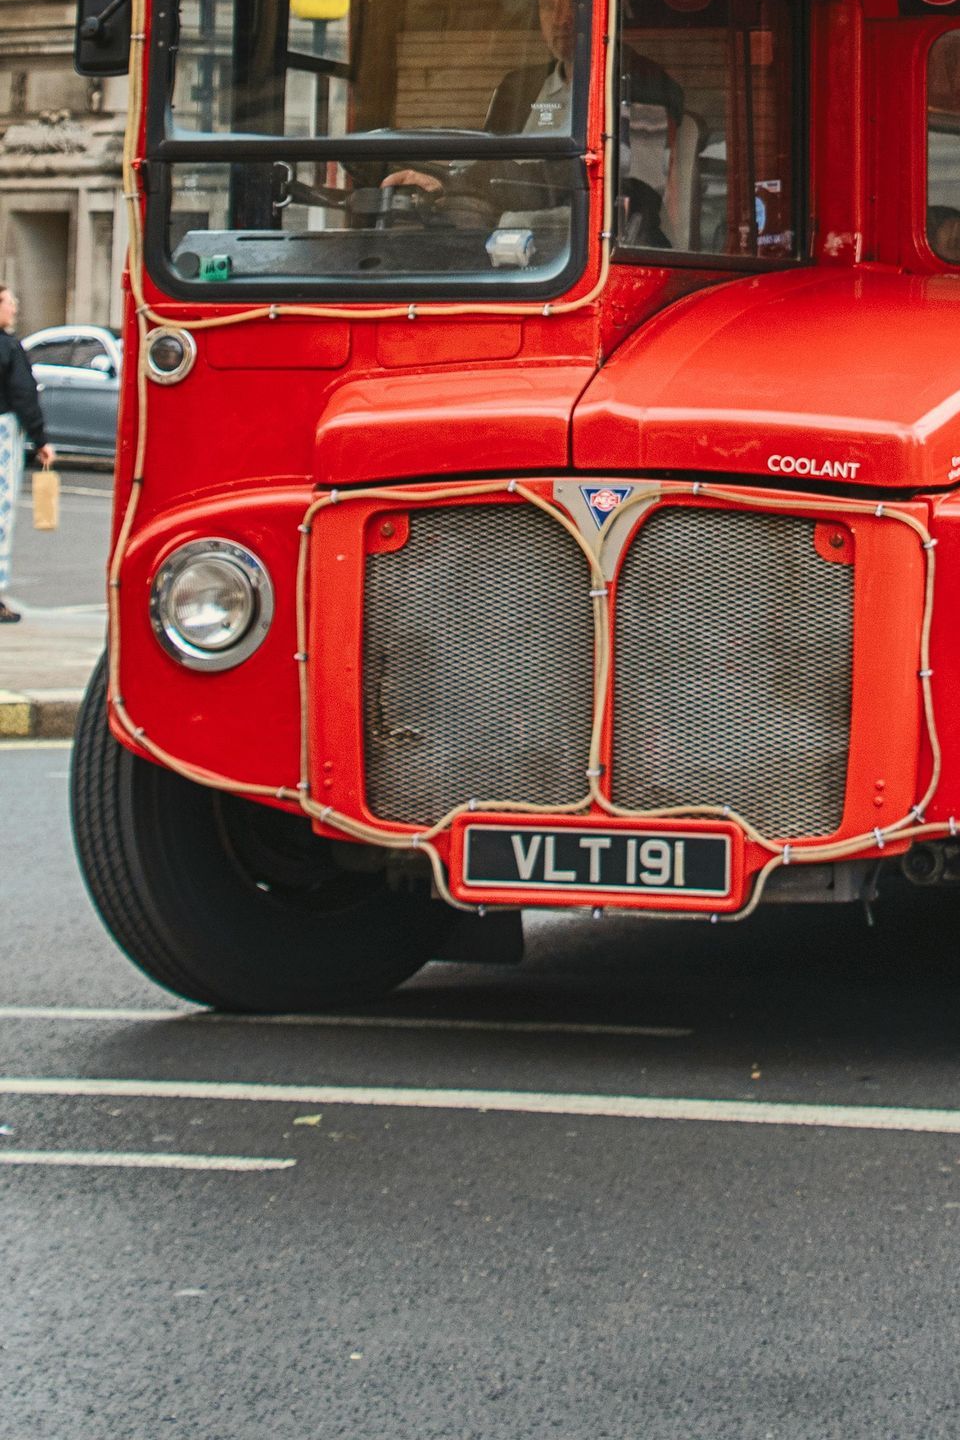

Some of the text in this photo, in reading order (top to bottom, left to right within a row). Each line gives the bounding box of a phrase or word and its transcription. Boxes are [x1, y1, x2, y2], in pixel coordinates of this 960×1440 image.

[767, 454, 861, 479] COOLANT
[511, 834, 685, 886] VLT 191
